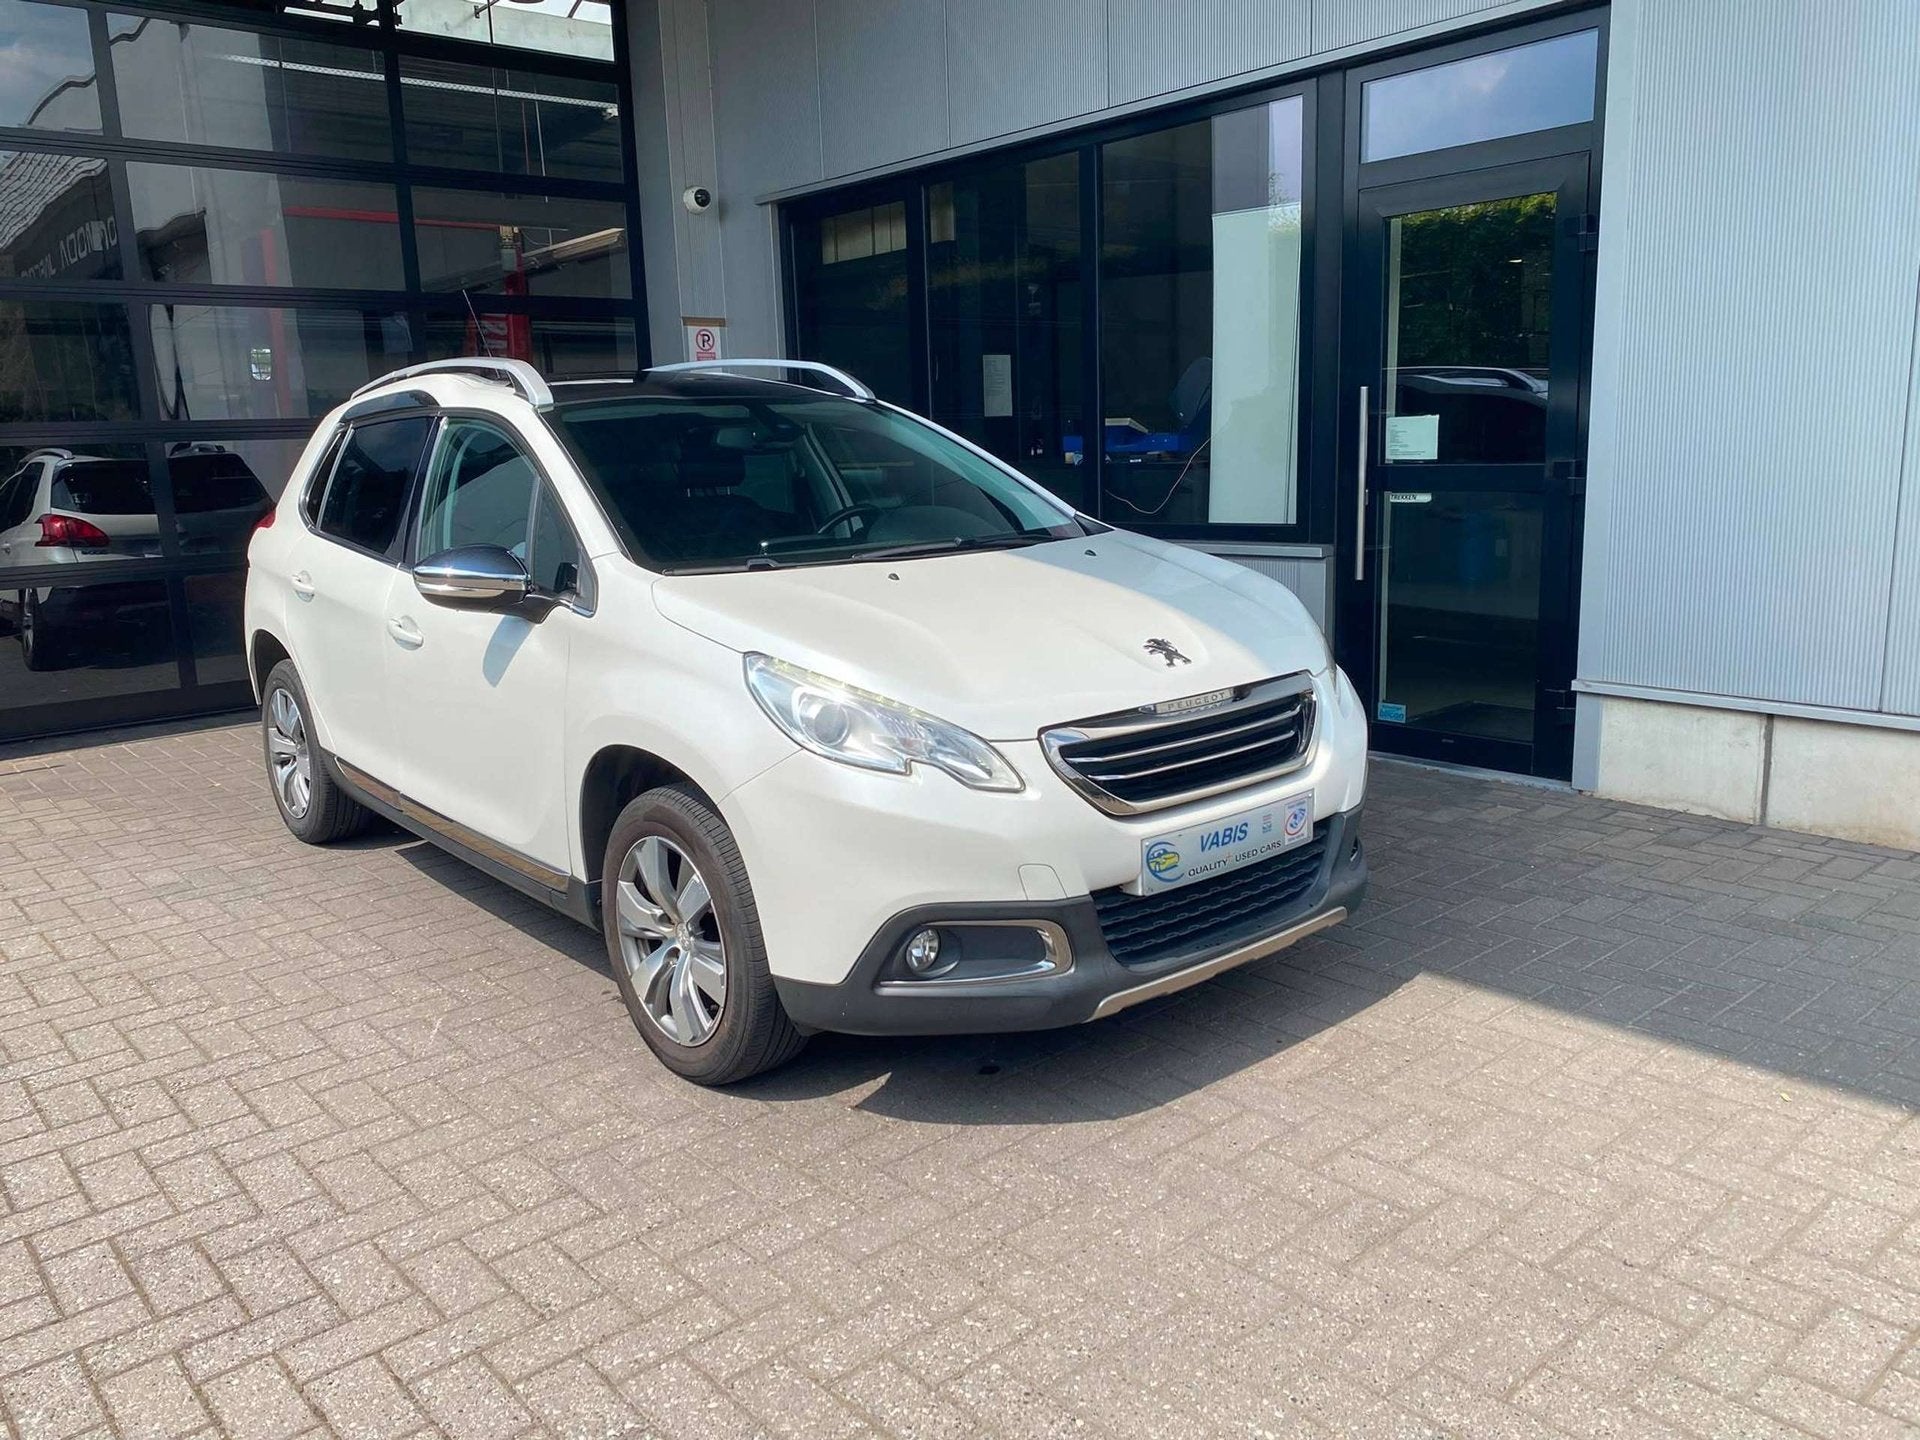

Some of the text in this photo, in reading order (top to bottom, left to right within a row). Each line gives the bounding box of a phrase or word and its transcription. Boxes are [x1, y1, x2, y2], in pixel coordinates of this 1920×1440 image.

[1167, 692, 1225, 711] PEUGEOT
[1200, 821, 1249, 853] VABIS
[1235, 847, 1258, 863] USED
[1259, 840, 1282, 855] CARS
